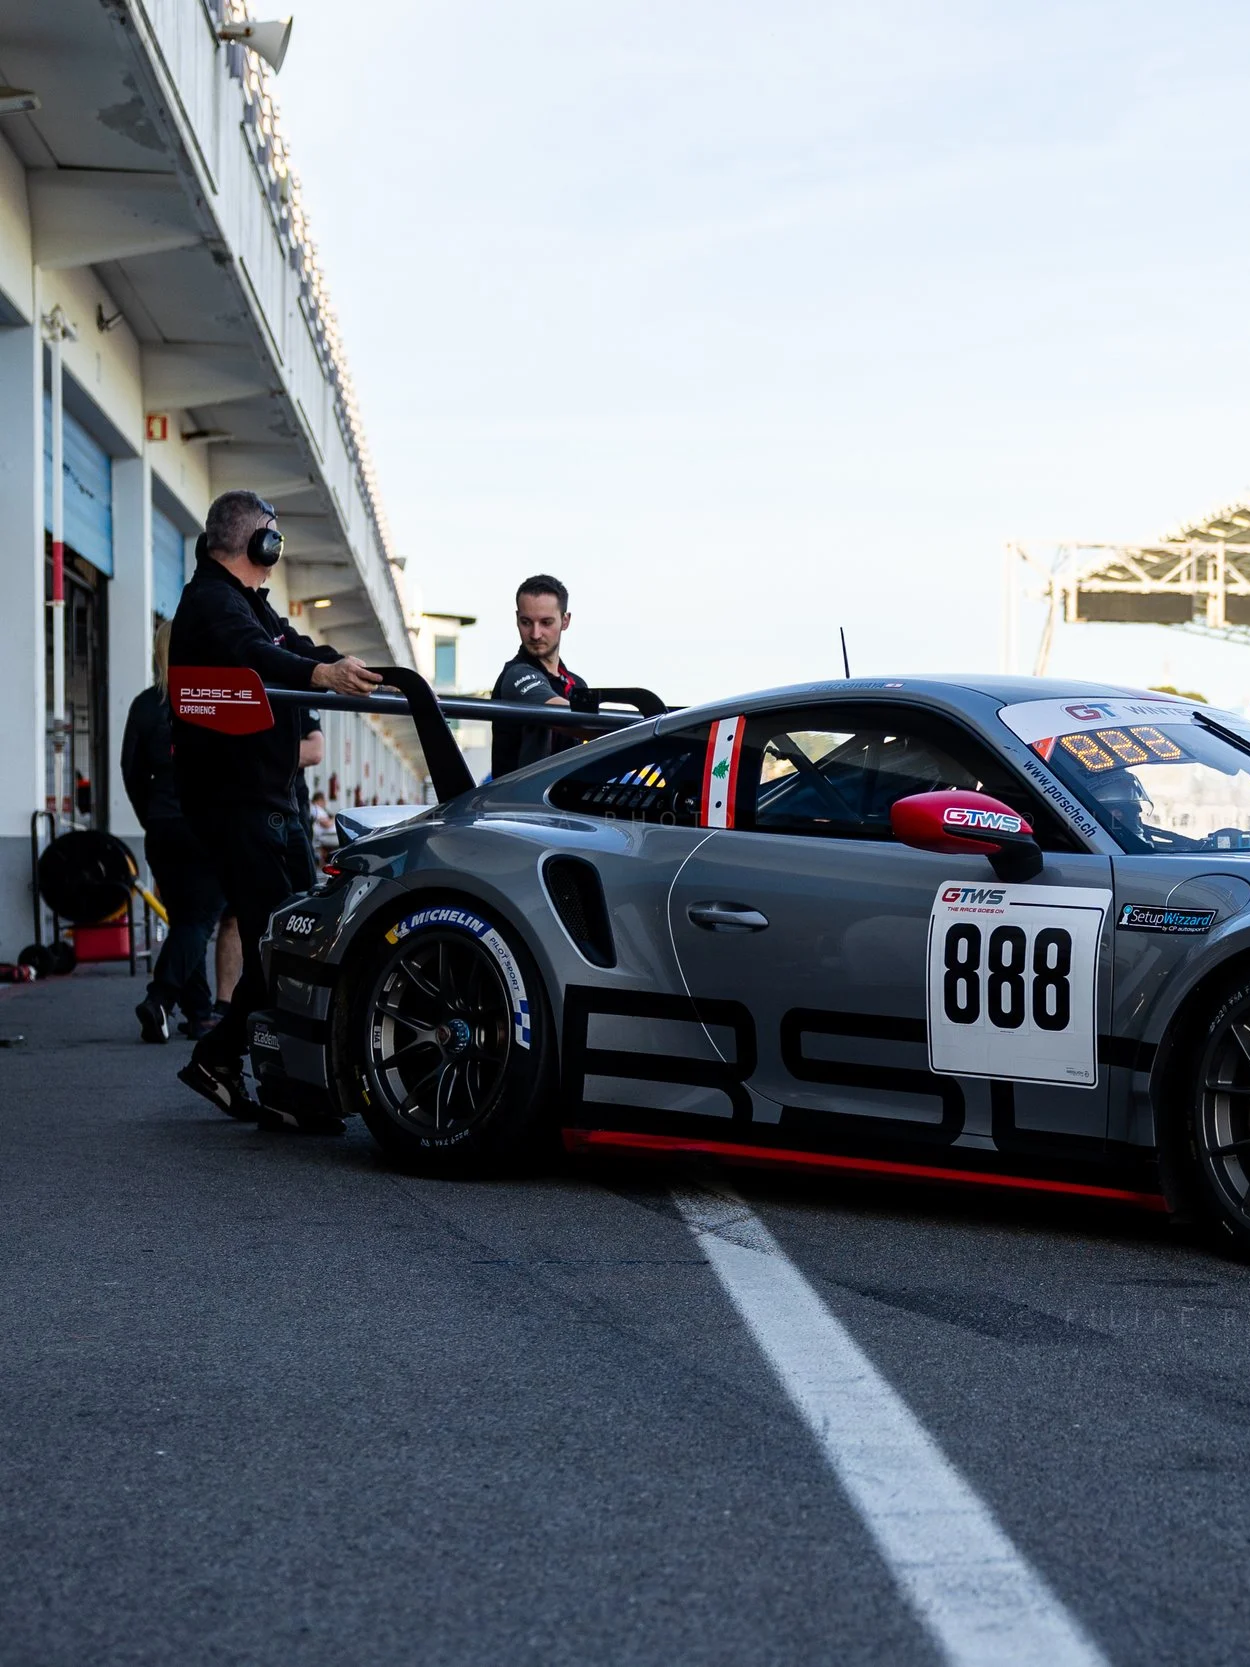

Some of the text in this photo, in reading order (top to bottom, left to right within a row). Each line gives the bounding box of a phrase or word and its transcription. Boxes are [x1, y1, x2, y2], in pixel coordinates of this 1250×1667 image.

[180, 705, 217, 715] EXPERIENCE
[1064, 702, 1119, 721] GT
[1060, 726, 1182, 773] 888
[1023, 760, 1098, 838] www.porsche.ch
[946, 809, 1020, 831] GTWS
[941, 887, 1006, 905] GTWS
[286, 914, 316, 935] BOSS
[1130, 909, 1211, 926] SetupWizzard
[410, 909, 520, 991] MICHELIN PILOT SPORT
[943, 922, 1073, 1033] 888
